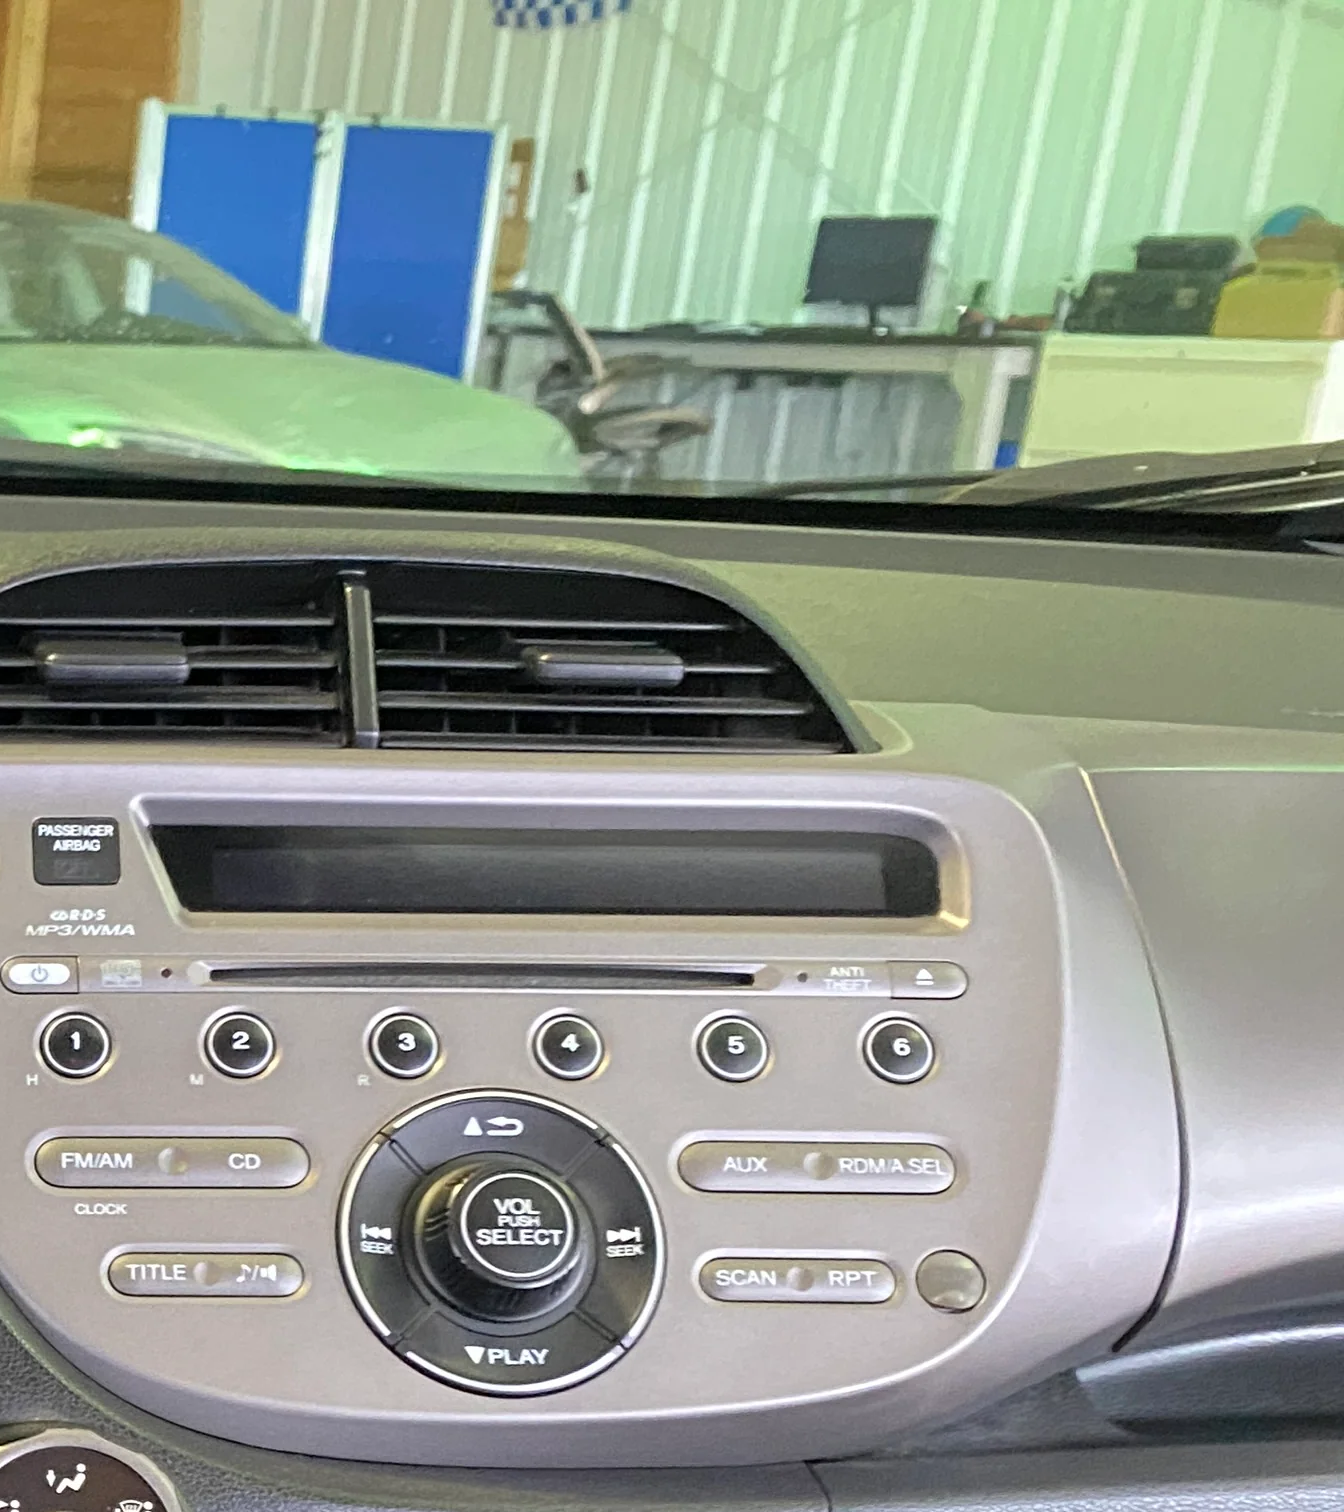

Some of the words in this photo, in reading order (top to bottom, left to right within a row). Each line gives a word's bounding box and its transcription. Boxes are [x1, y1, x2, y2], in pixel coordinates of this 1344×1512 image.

[37, 824, 114, 837] PASSENGER
[52, 839, 101, 852] AIRBAG
[24, 924, 136, 937] MP3/WMA
[829, 966, 865, 977] ANTI
[823, 978, 873, 992] THEFT
[69, 1031, 82, 1050] 1
[231, 1031, 250, 1050] 2
[397, 1032, 416, 1052] 3
[561, 1032, 581, 1052] 4
[727, 1035, 745, 1055] 5
[893, 1037, 912, 1056] 6
[25, 1074, 38, 1086] H
[189, 1074, 204, 1086] M
[61, 1152, 133, 1169] FM/AM
[228, 1153, 261, 1170] CD
[723, 1156, 768, 1173] AUX
[73, 1203, 128, 1215] CLOCK
[493, 1198, 541, 1215] VOL
[497, 1215, 541, 1227] PUSH
[476, 1229, 564, 1246] SELECT
[360, 1241, 395, 1255] SEEK
[606, 1244, 645, 1257] SEEK
[125, 1264, 187, 1281] TITLE
[715, 1269, 777, 1286] SCAN
[828, 1271, 881, 1286] RPT
[488, 1349, 549, 1365] PLAY
